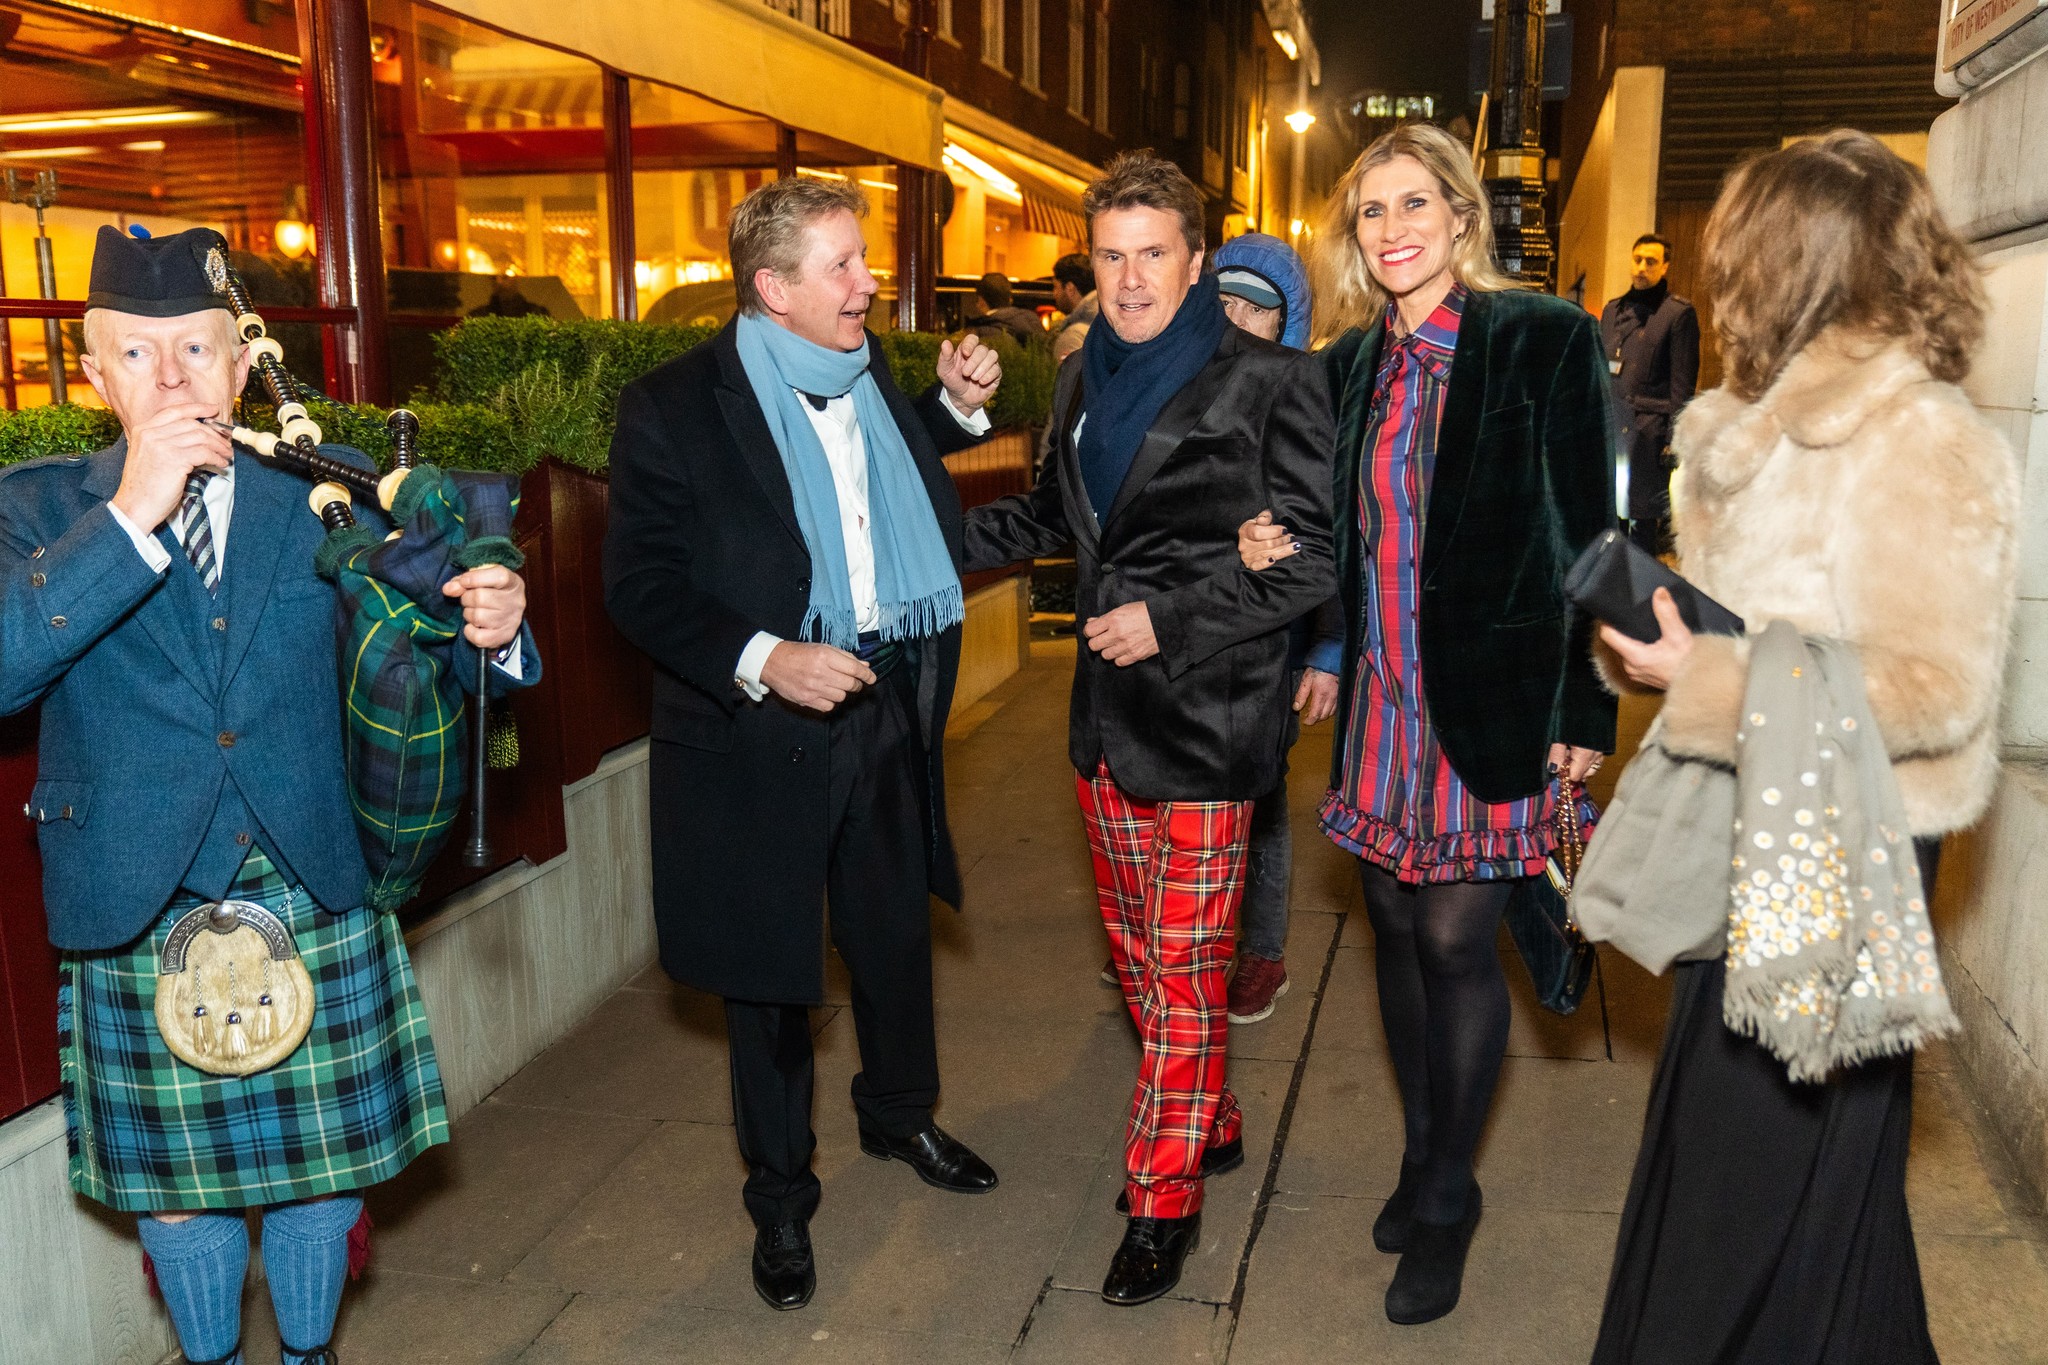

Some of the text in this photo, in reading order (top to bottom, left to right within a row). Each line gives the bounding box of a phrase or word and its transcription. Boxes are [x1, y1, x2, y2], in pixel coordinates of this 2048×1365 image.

[1951, 0, 2018, 49] CITY OF WESTMINS
